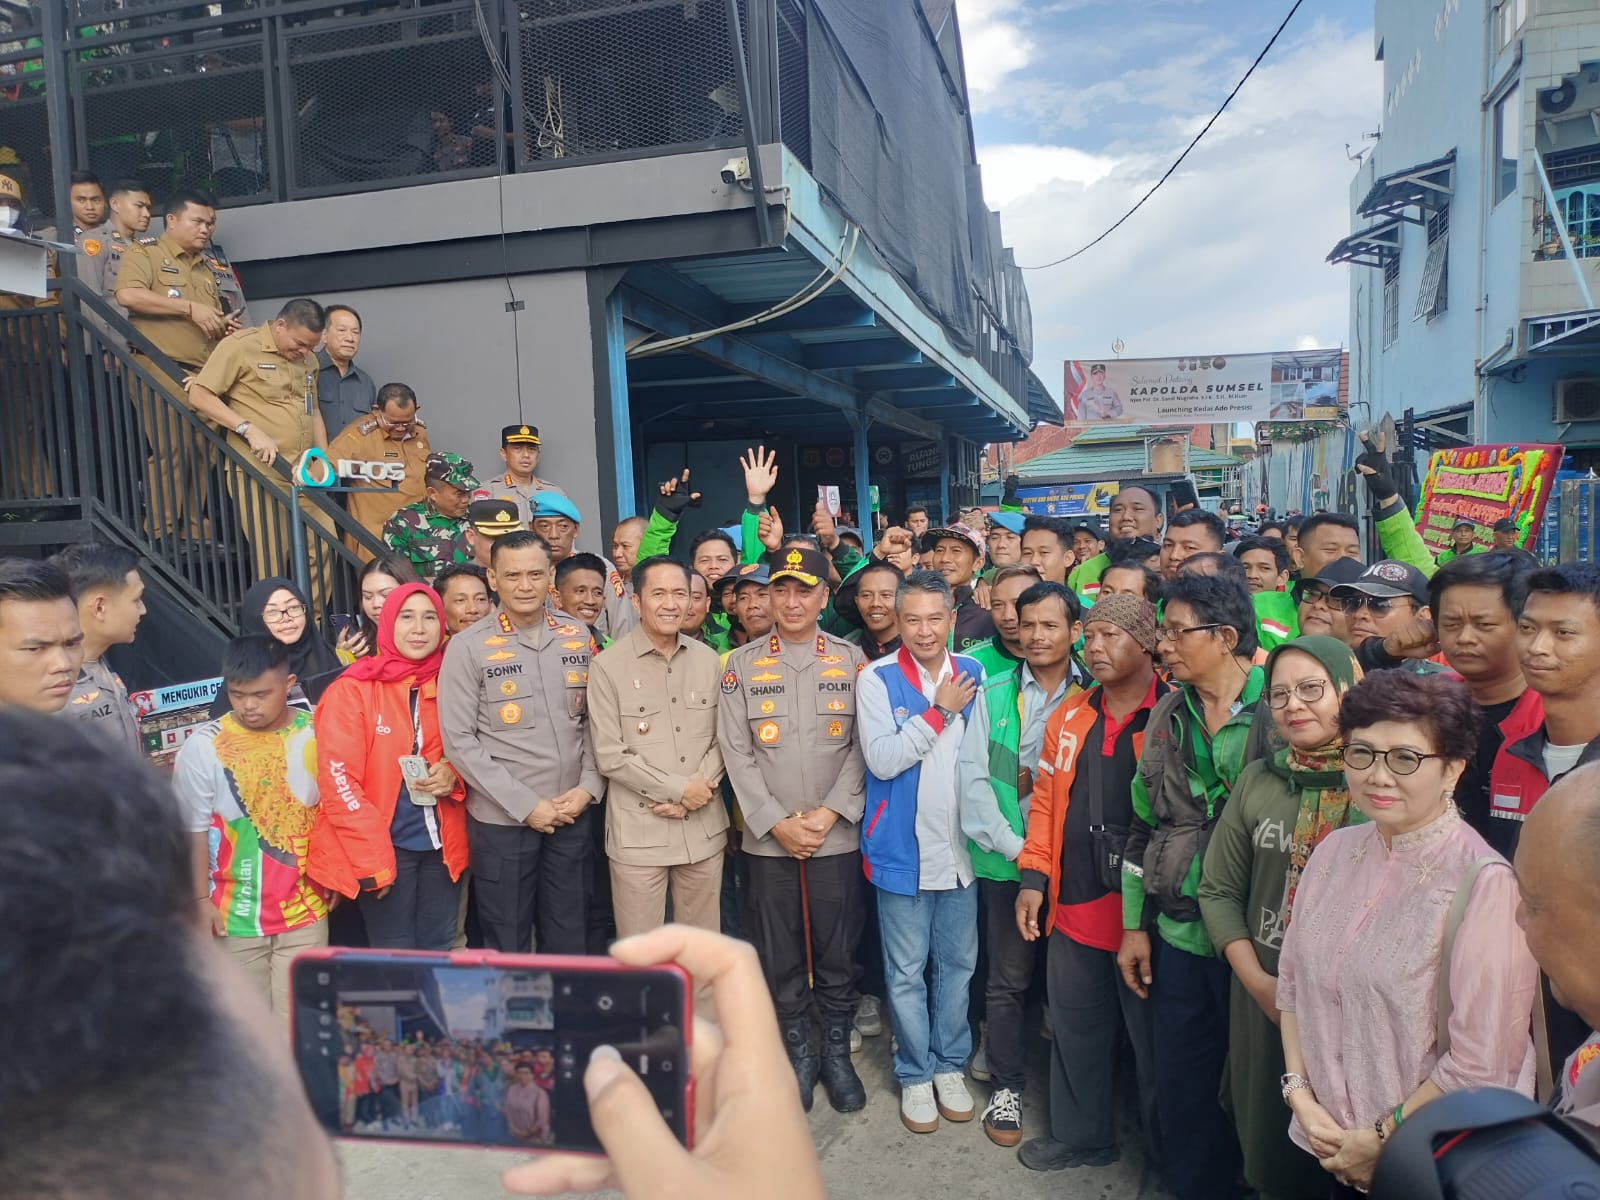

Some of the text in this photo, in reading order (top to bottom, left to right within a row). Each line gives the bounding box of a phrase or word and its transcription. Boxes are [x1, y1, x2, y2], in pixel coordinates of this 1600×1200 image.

[1130, 382, 1264, 396] KAPOLDA SUMSEL
[338, 459, 405, 483] IQOS
[905, 456, 939, 473] TUNGG
[487, 664, 524, 678] SONNY
[750, 685, 785, 696] SHANDI
[818, 682, 851, 692] POLRI
[161, 684, 209, 705] MENGUKIR
